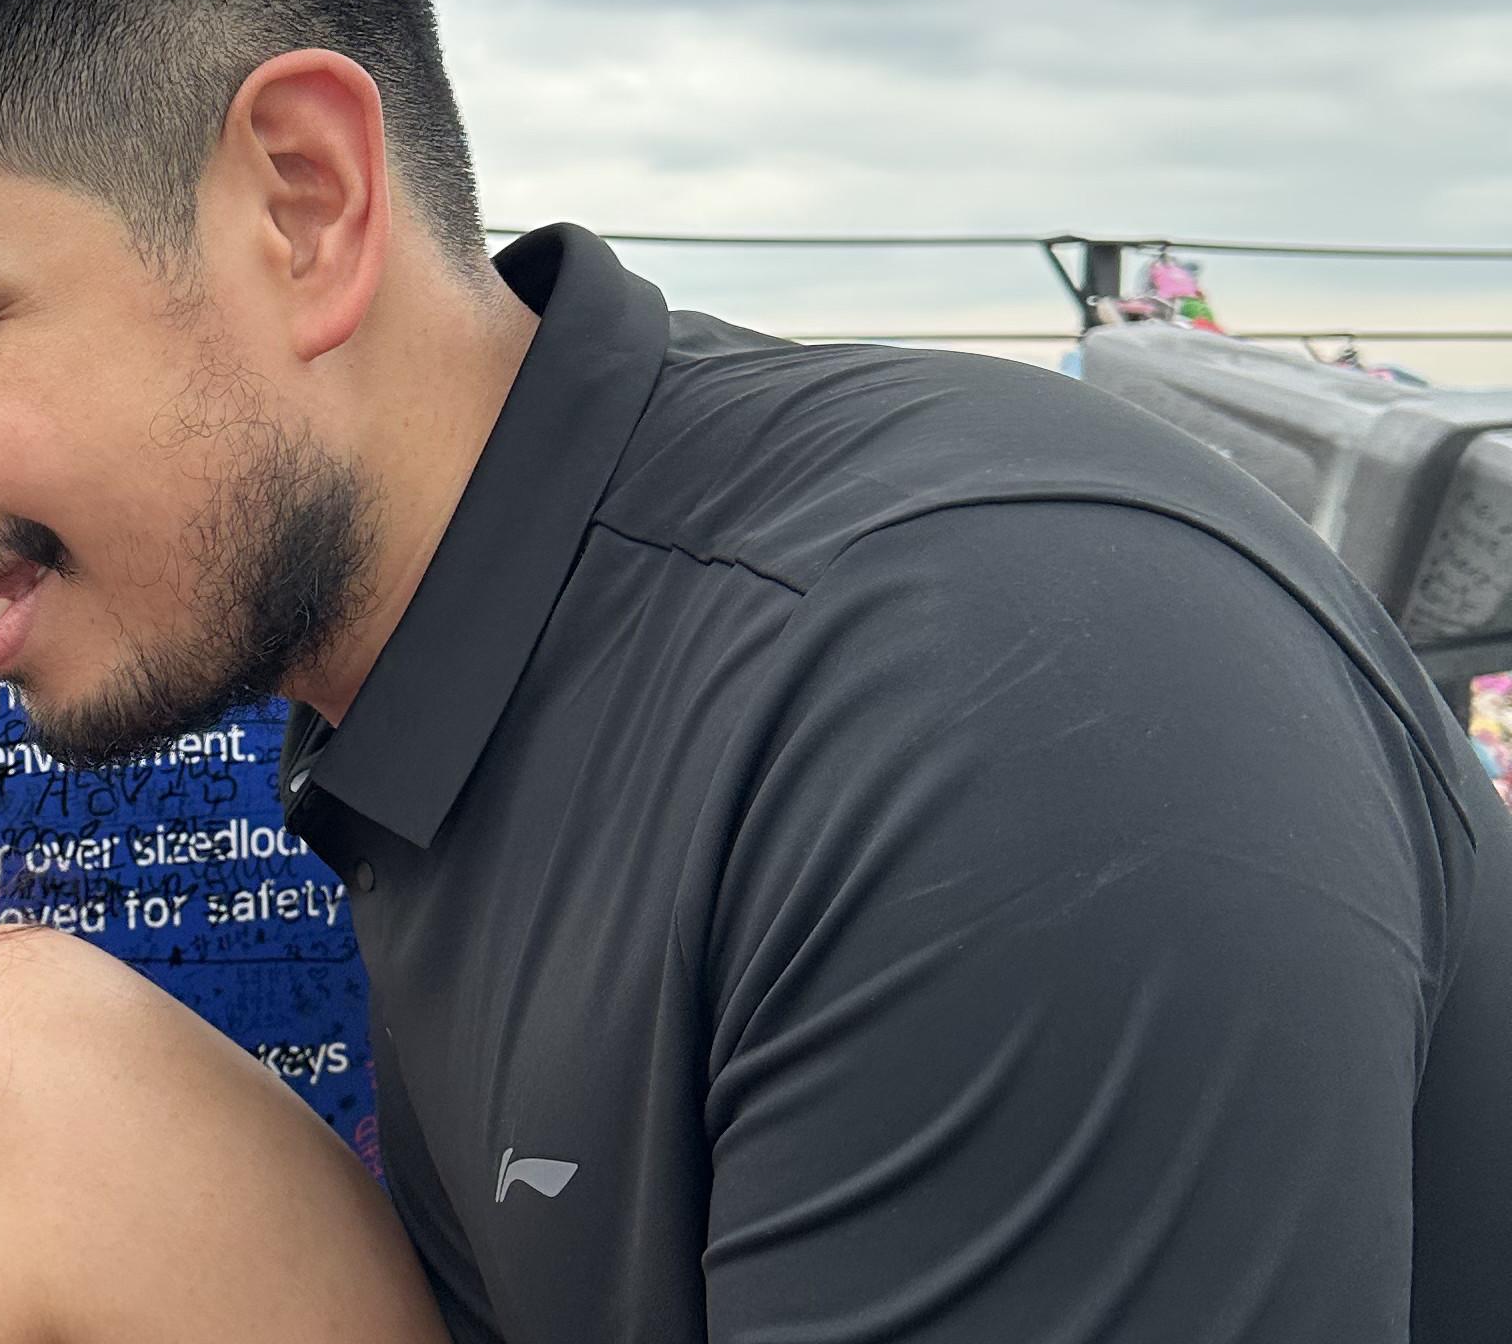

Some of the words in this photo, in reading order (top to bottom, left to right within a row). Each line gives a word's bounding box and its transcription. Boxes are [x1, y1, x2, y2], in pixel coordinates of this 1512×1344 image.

[25, 835, 122, 874] over
[125, 890, 188, 930] for
[207, 879, 346, 928] safety
